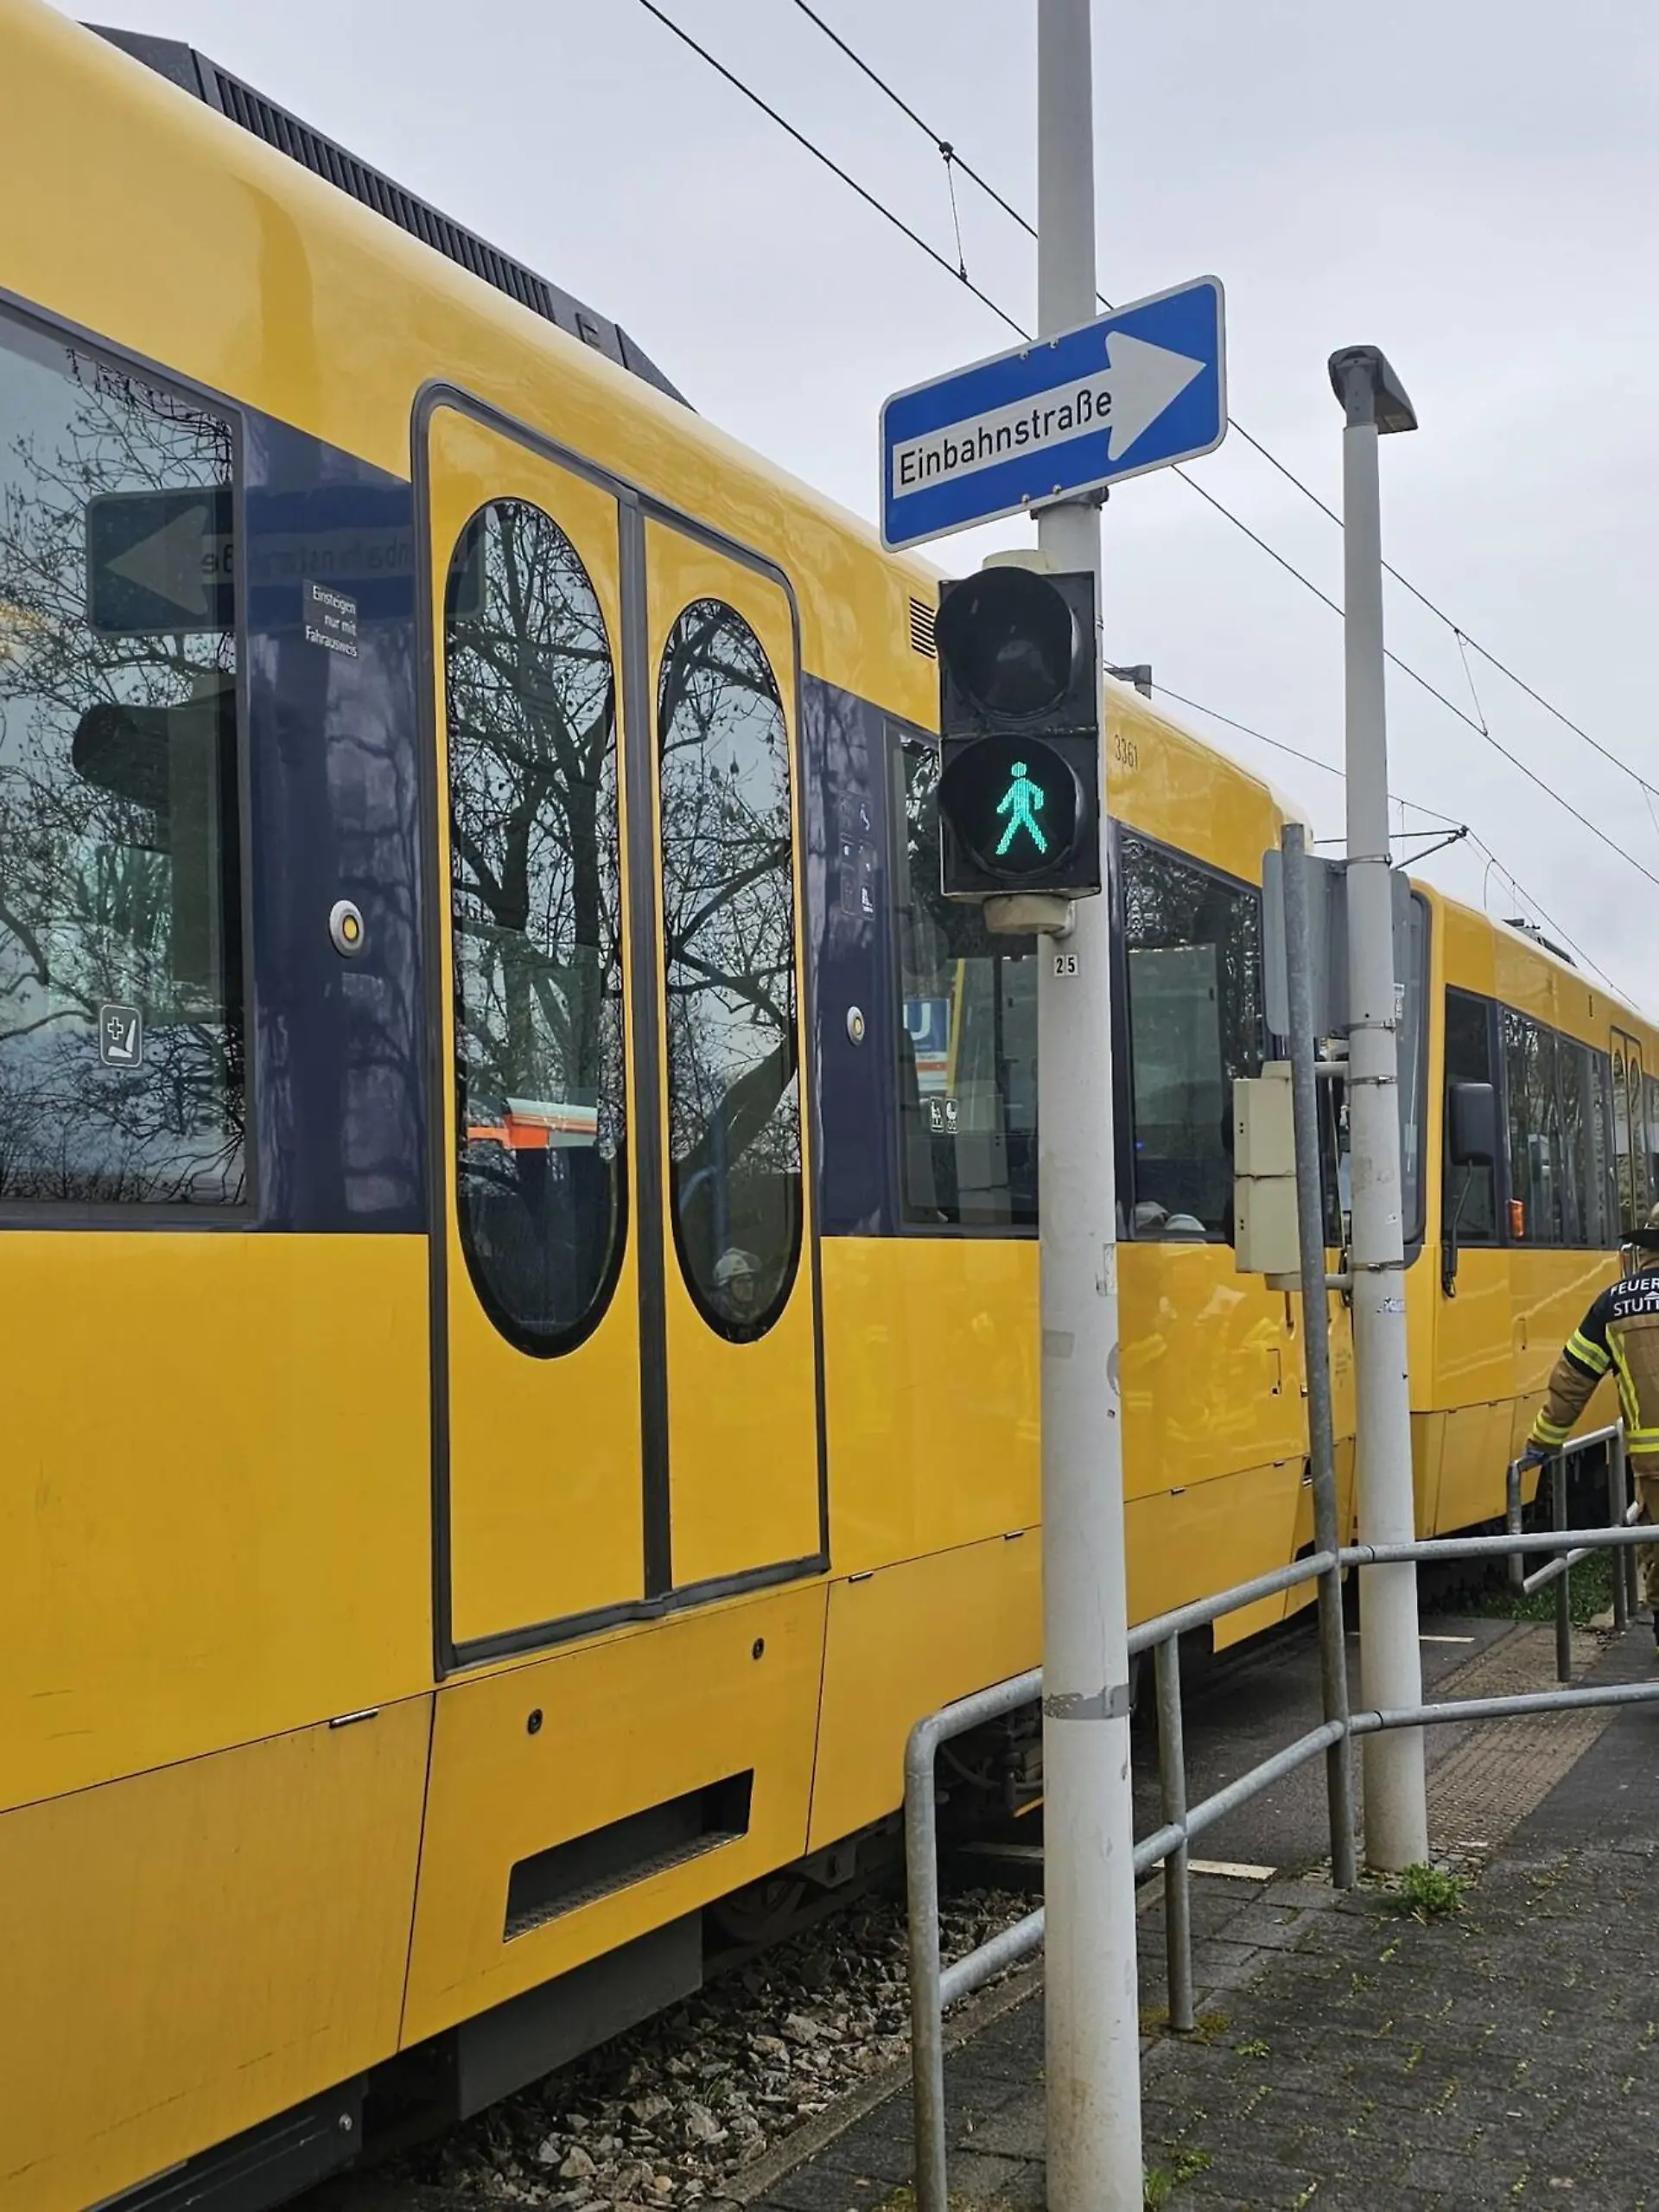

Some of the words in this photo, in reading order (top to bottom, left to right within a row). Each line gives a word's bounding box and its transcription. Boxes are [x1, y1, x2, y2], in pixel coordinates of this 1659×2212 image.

[899, 390, 1112, 486] Einbahnstraße
[324, 615, 340, 629] nur
[341, 620, 356, 637] mit
[1114, 734, 1139, 771] 3361
[1056, 957, 1076, 974] 25
[903, 1002, 931, 1040] U
